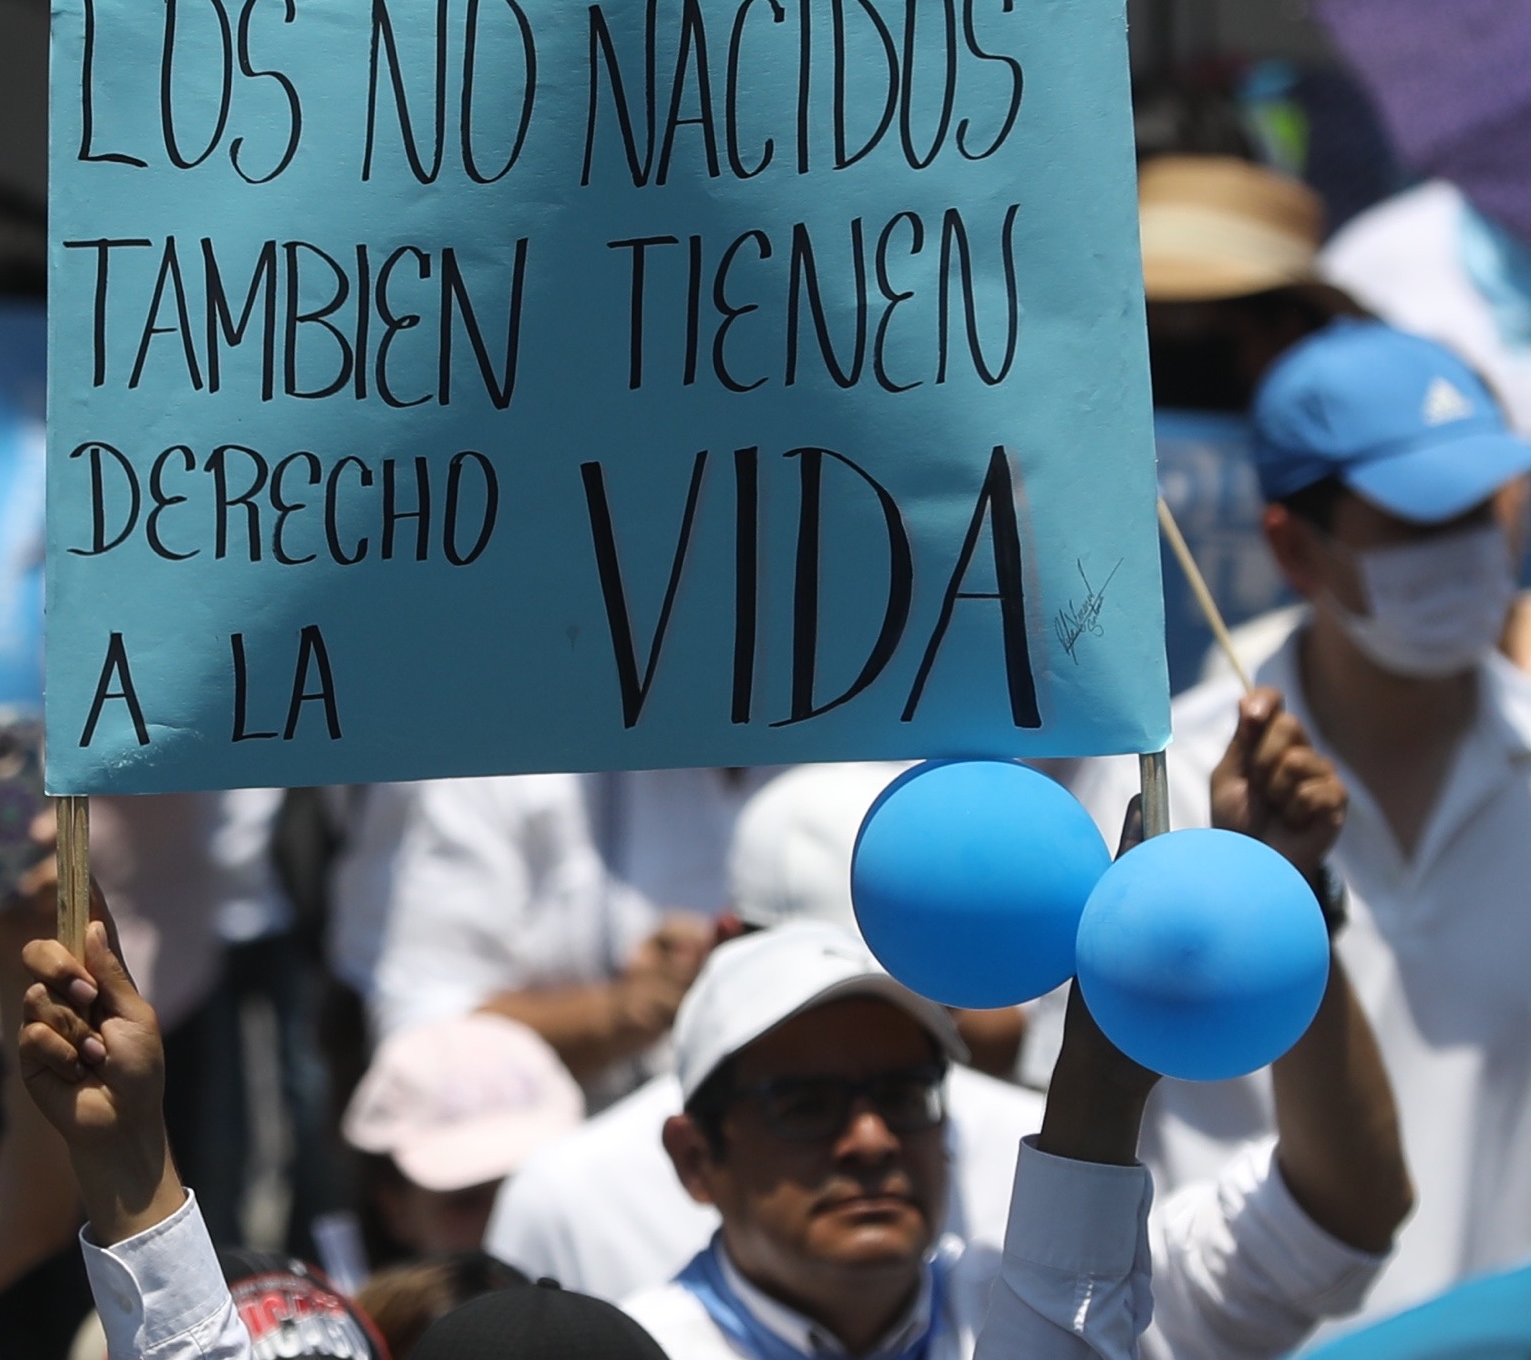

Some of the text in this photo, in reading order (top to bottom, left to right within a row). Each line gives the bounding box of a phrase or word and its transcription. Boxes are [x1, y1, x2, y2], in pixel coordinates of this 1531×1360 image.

[63, 203, 1021, 409] TAMBIEN TIENEN
[68, 441, 500, 568] DERECHO
[79, 631, 150, 748] A
[230, 624, 343, 742] LA
[581, 443, 1044, 730] VIDA
